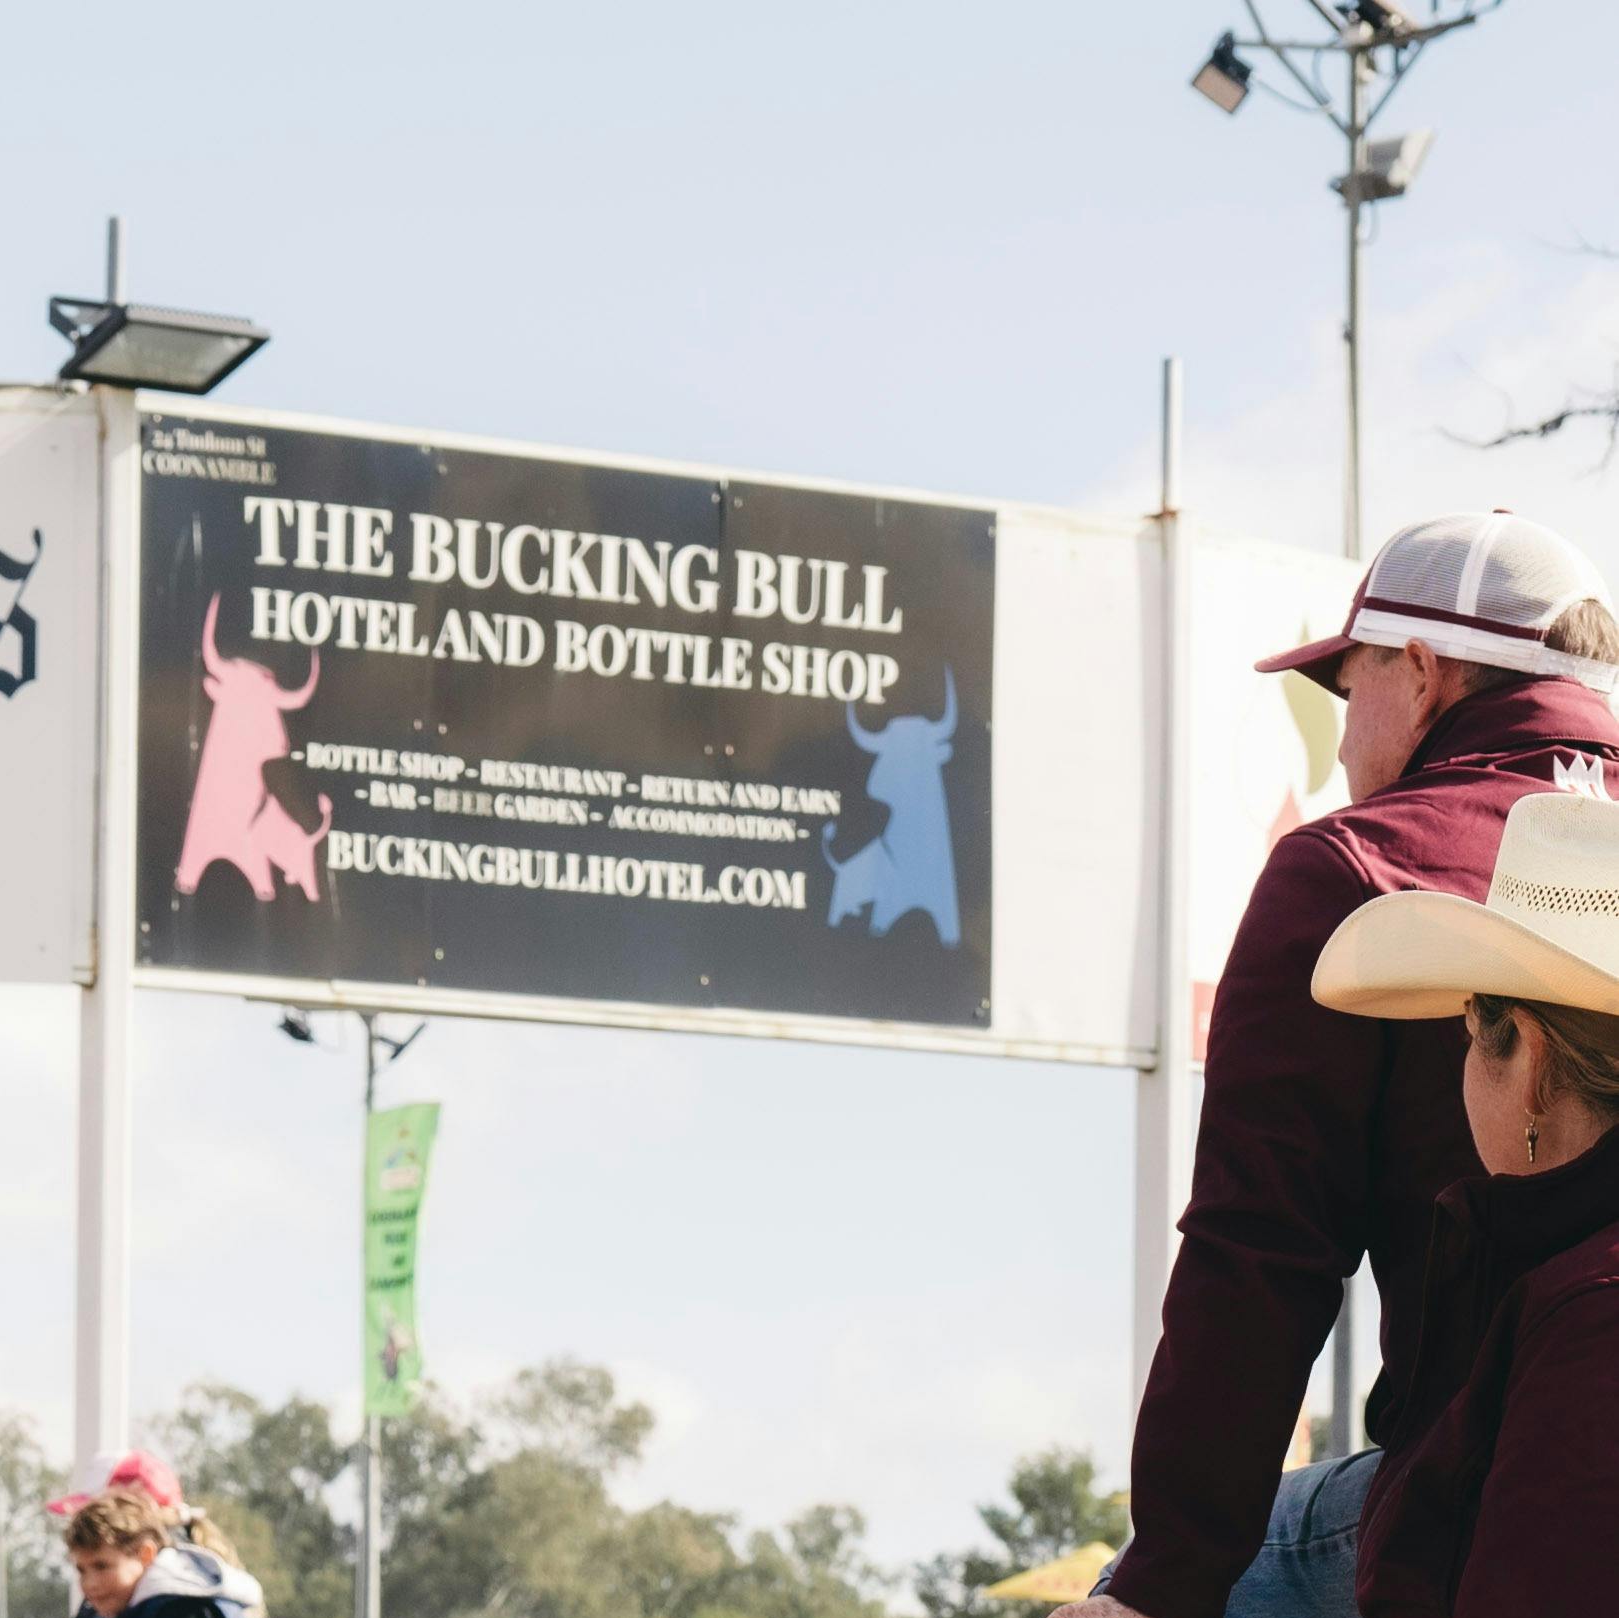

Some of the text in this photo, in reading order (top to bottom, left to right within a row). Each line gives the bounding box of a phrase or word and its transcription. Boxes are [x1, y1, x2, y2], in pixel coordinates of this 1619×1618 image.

[243, 495, 903, 634] THE BUCKING BULL
[250, 586, 900, 705] HOTEL AND BOTTLE SHOP
[306, 742, 841, 816] BOTTLE SHOP RESTAURANT RETURN AND EARN
[369, 780, 417, 810] BAR
[494, 793, 589, 826] GARDEN
[326, 829, 807, 910] BUCKINGBULLHOTEL.COM
